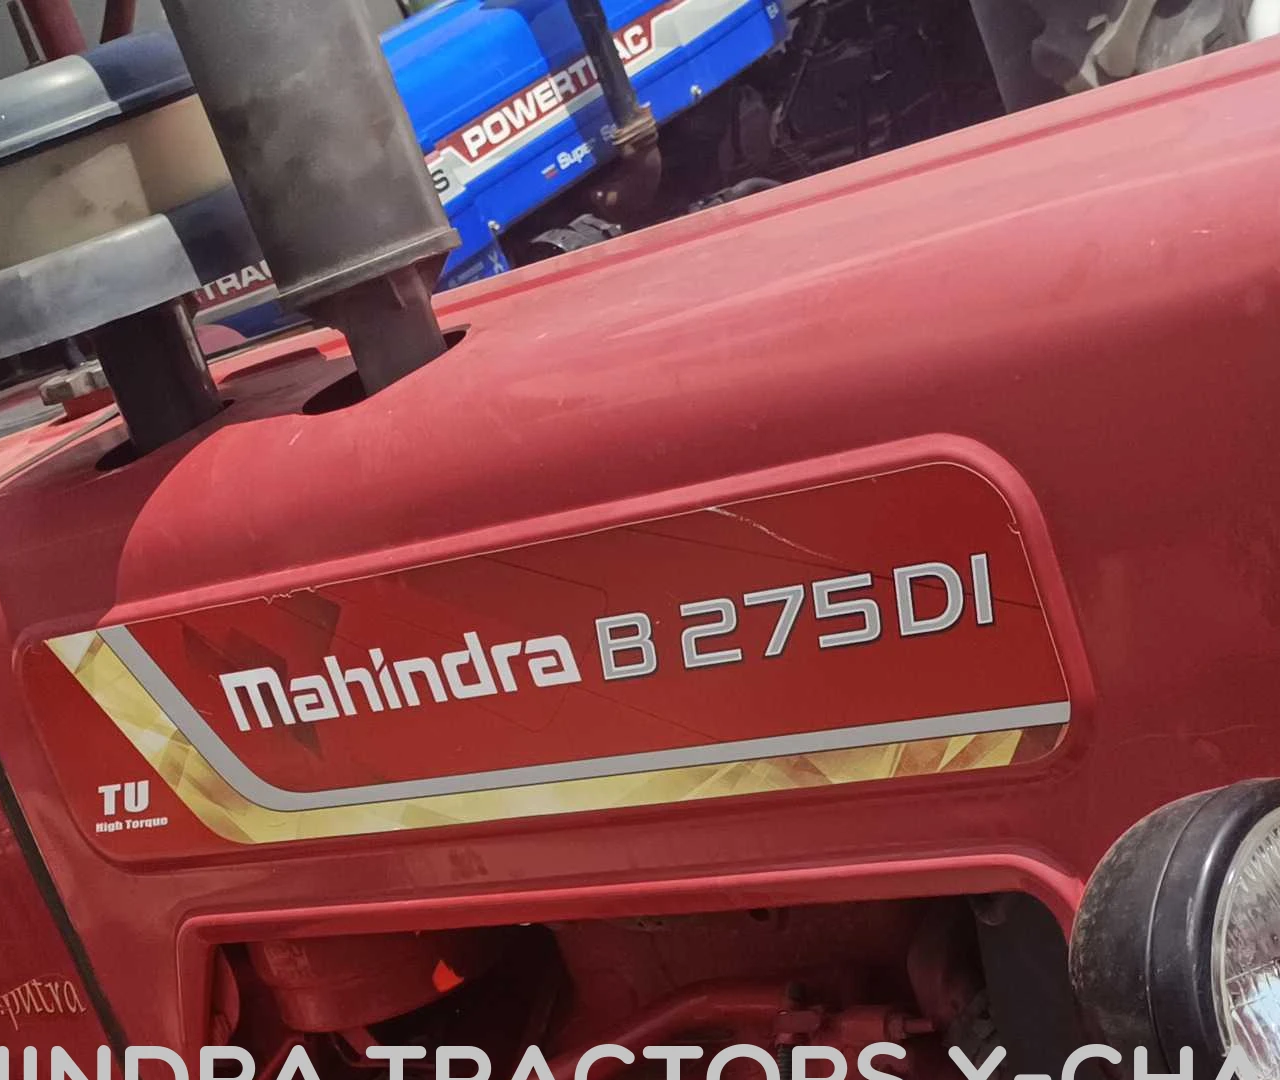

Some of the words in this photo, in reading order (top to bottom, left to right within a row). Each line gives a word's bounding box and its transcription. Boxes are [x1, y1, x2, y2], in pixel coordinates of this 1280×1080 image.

[462, 24, 649, 157] POWERTAC
[219, 631, 582, 731] Mahindra
[595, 612, 657, 681] B
[95, 821, 123, 833] High
[125, 816, 169, 830] Torque
[98, 780, 149, 816] TU
